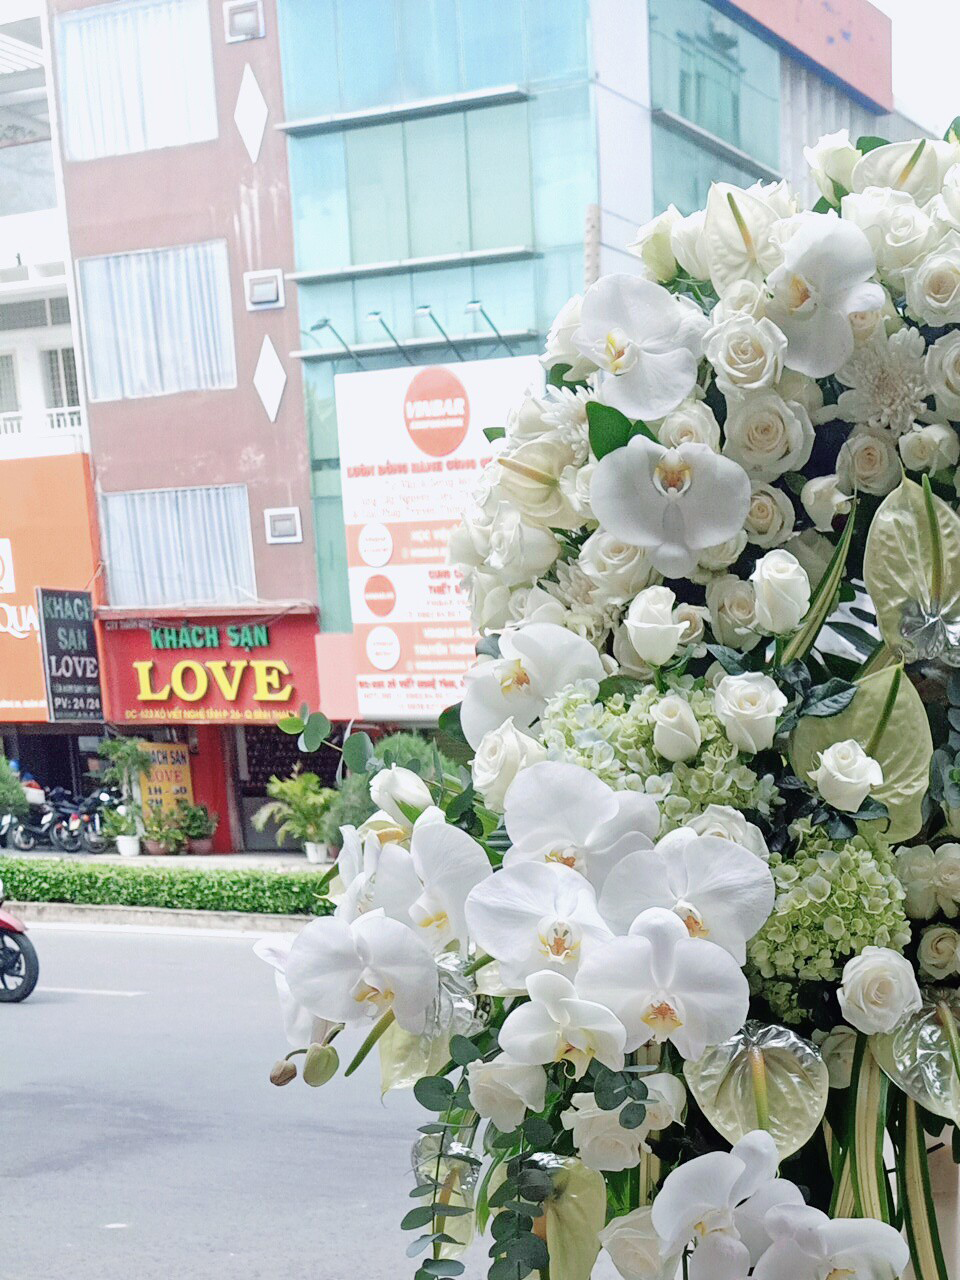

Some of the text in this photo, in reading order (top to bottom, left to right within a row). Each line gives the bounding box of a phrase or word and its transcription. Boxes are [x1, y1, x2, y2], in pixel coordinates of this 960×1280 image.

[57, 626, 88, 654] SẠN
[151, 620, 270, 652] KHÁCH SẠN
[50, 654, 99, 678] LOVE
[132, 659, 295, 702] LOVE
